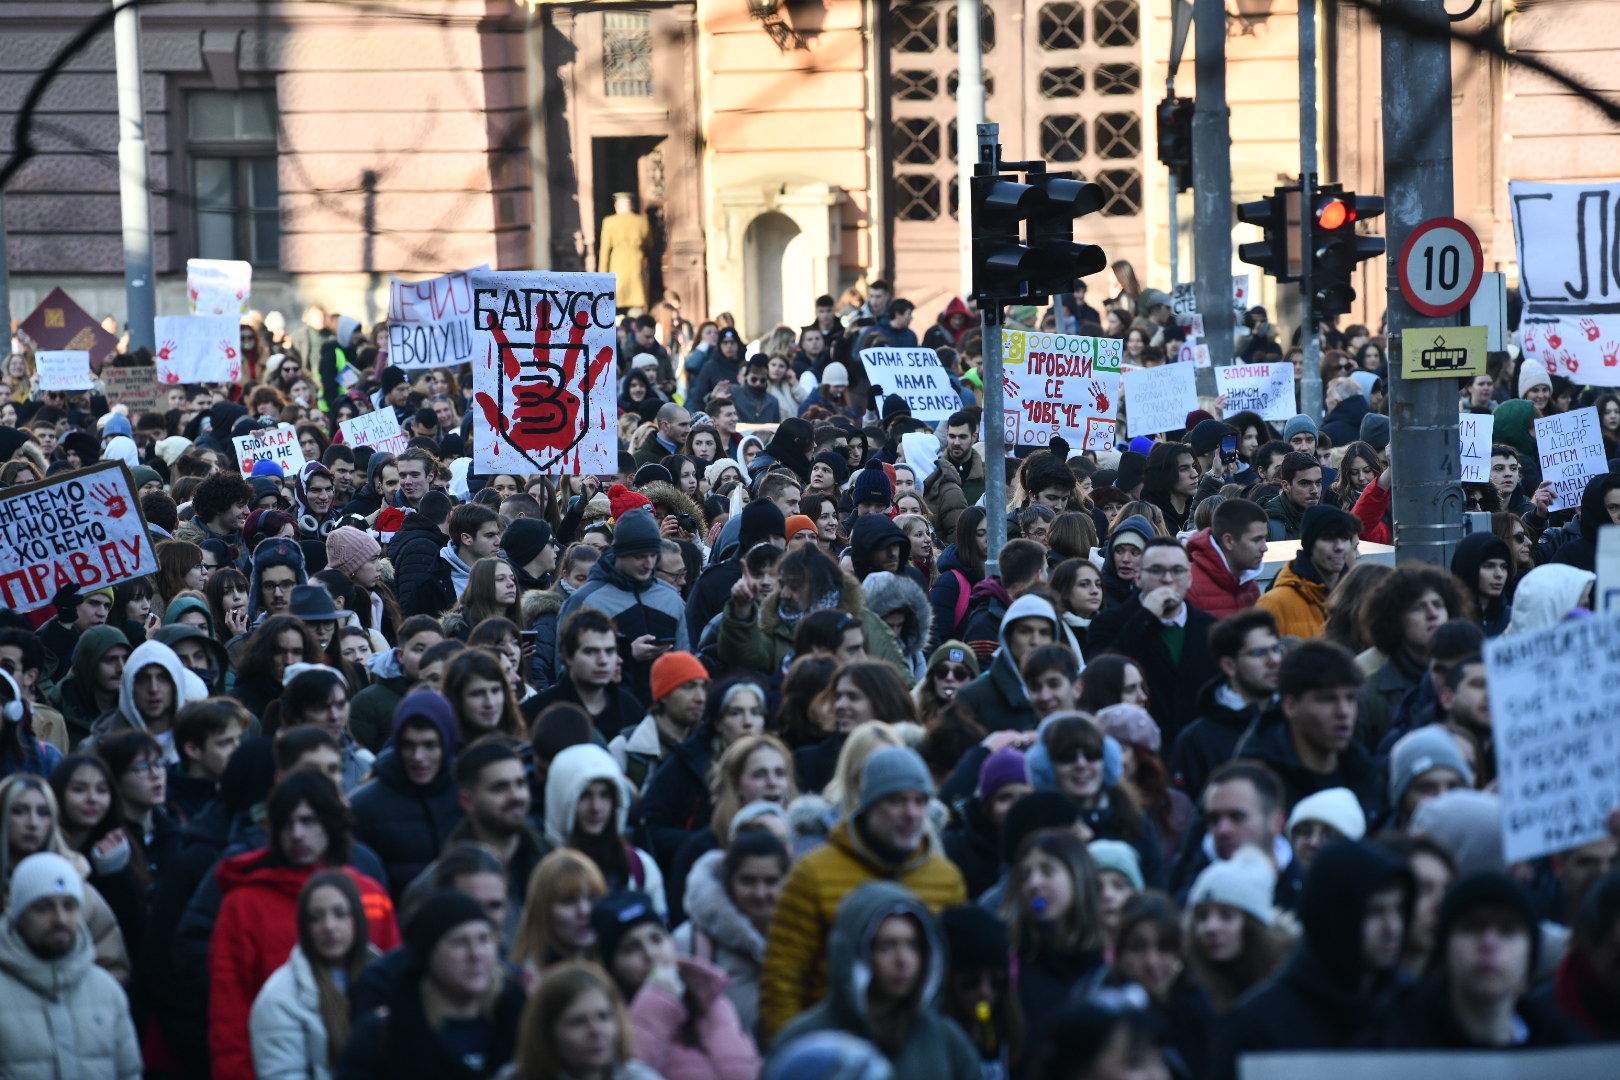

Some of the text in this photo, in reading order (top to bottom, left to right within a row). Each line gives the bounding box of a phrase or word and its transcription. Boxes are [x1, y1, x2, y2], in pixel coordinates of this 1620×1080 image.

[1424, 245, 1459, 291] 10
[865, 351, 904, 367] VAMA
[1028, 352, 1093, 378] ПРОБУДИ
[895, 373, 937, 389] NAMA
[1224, 365, 1269, 380] ЗЛОЧИН
[1045, 379, 1064, 398] СЕ
[1227, 388, 1259, 398] НИКОМ
[1226, 393, 1269, 410] НИШТА?
[1022, 399, 1082, 428] ЧОВЕЧЕ
[350, 420, 358, 434] А
[1537, 413, 1591, 438] БАШ ЈЕ
[241, 431, 294, 451] БЛОКАДА
[354, 430, 369, 445] ВИ
[1549, 429, 1587, 451] ДОБАР
[253, 445, 293, 463] АКО НЕ
[1542, 448, 1578, 469] СИСТЕМ
[1561, 463, 1586, 478] КОЈИ
[0, 481, 85, 524] НЕЋЕМО
[0, 503, 89, 550] ТАНОВЕ
[14, 522, 107, 566] ХОЋЕМО
[0, 535, 141, 609] ПРАВДУ
